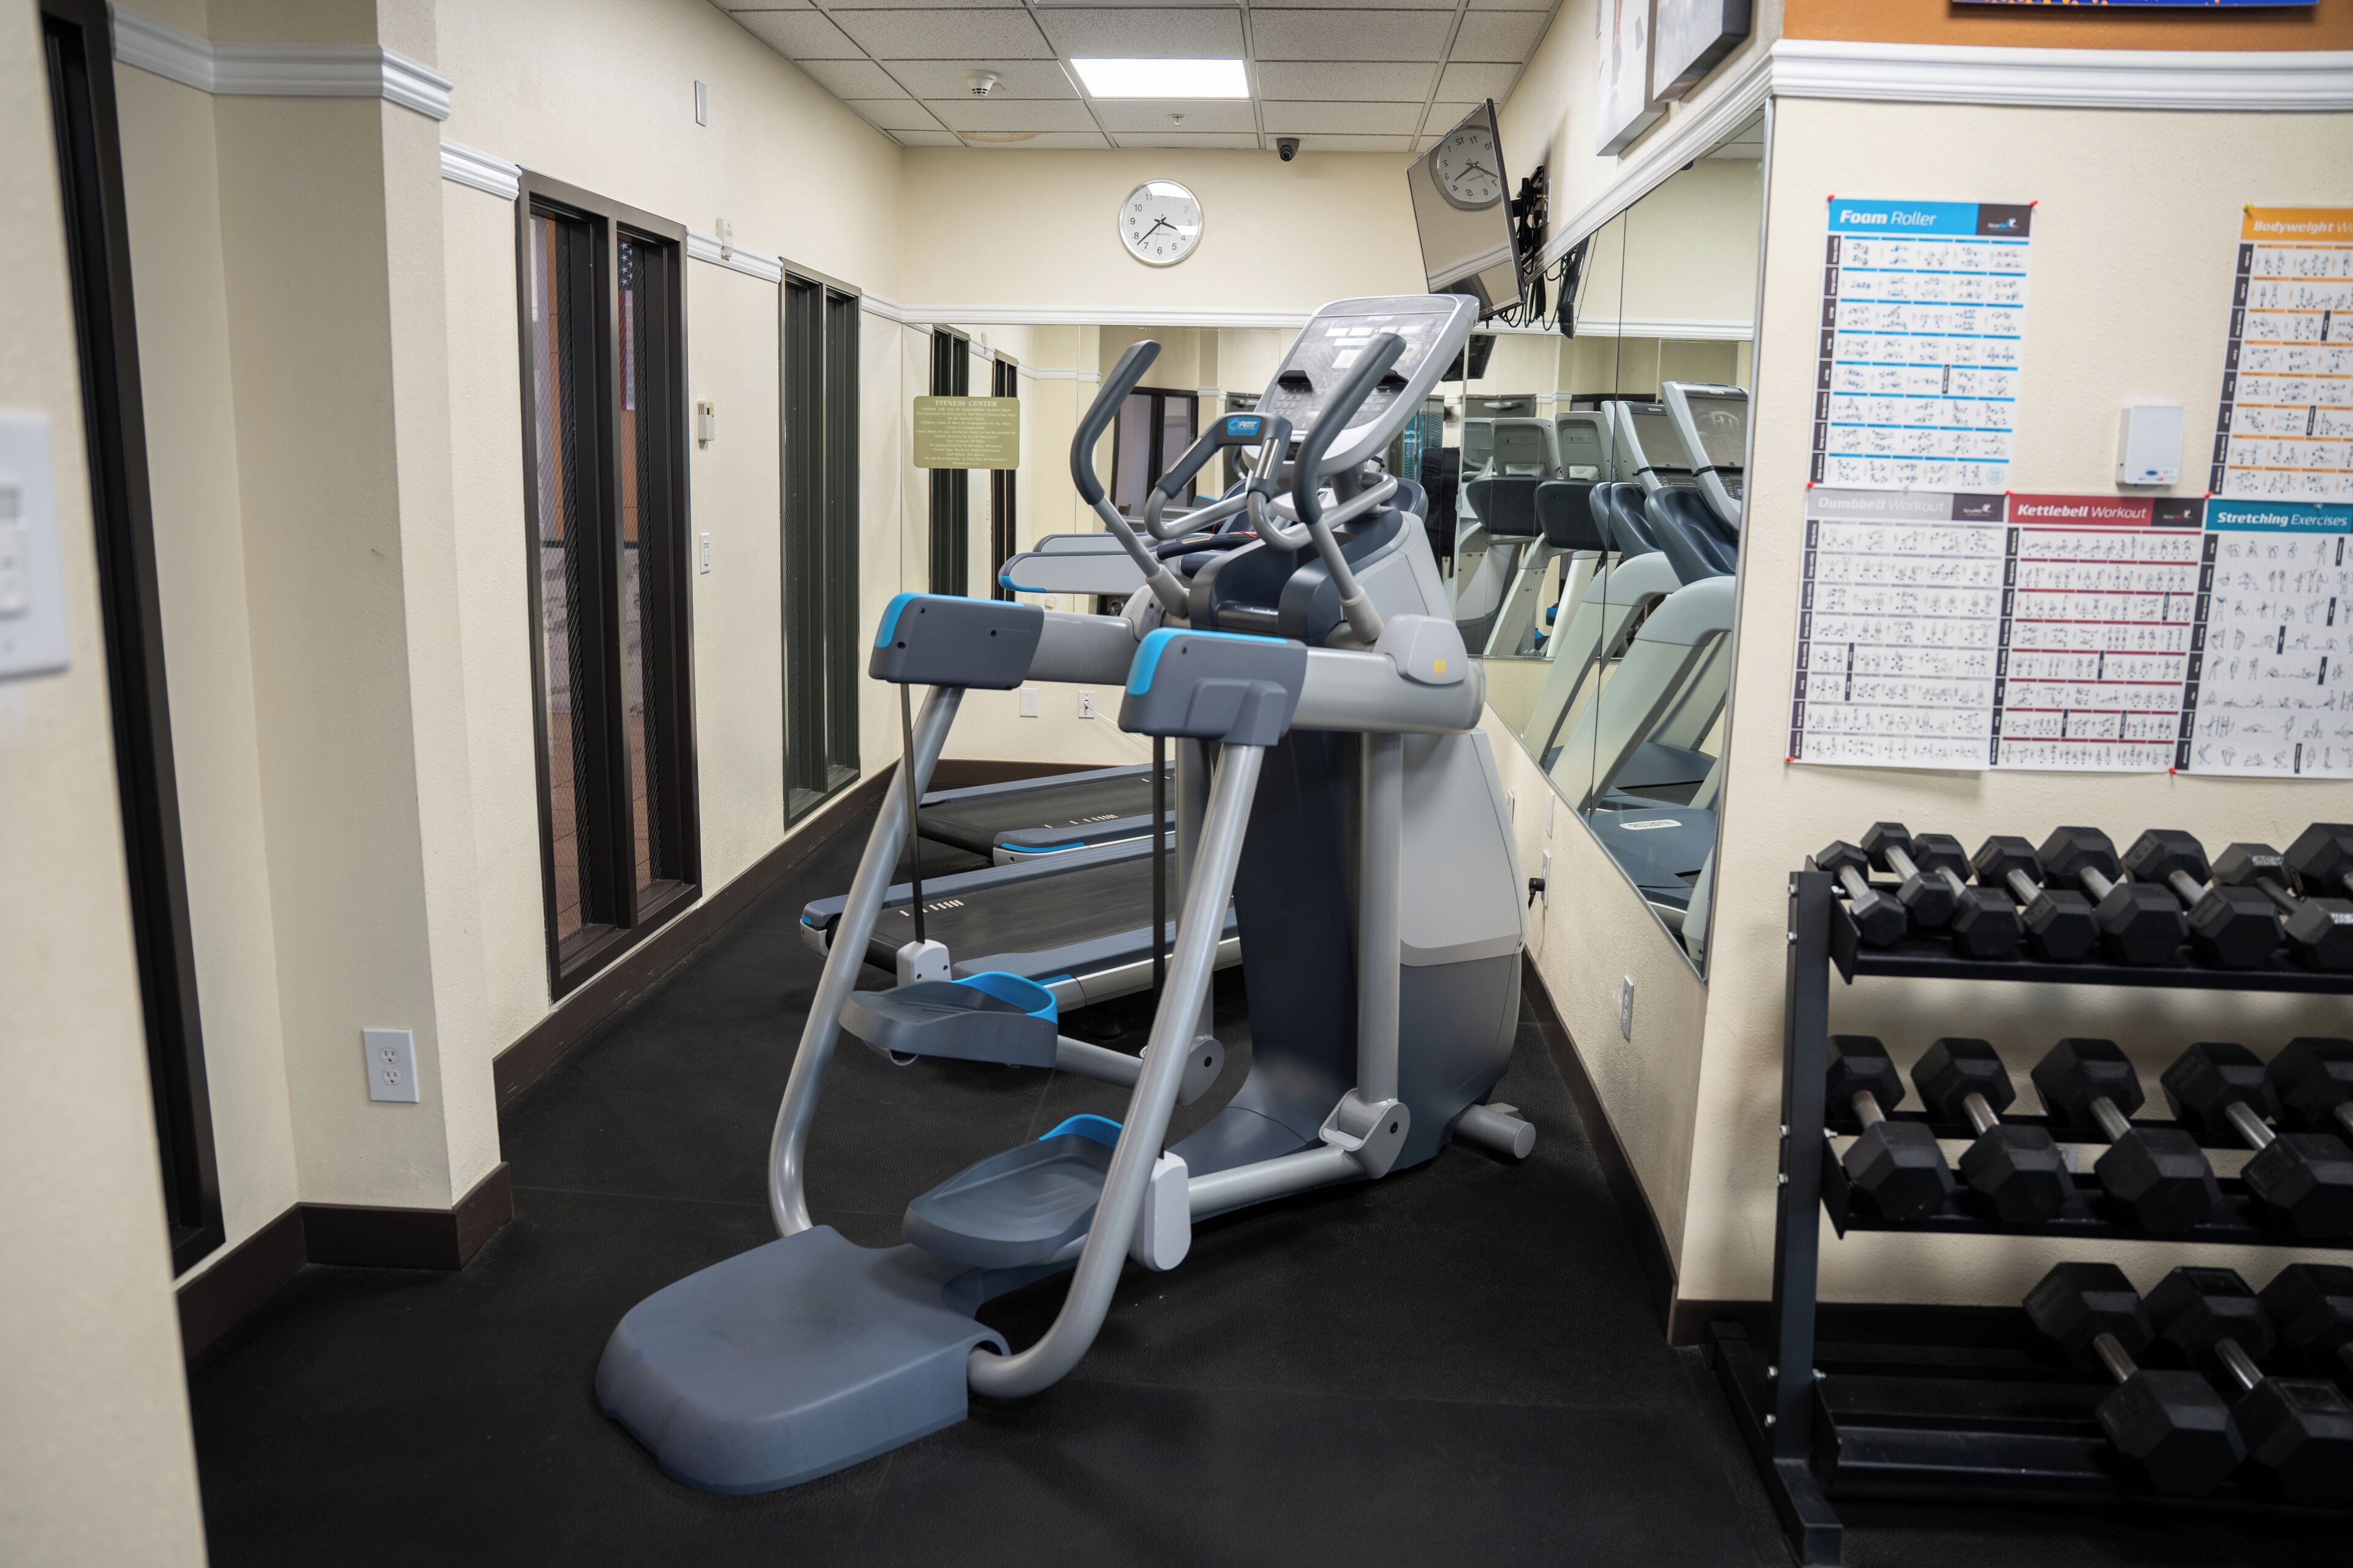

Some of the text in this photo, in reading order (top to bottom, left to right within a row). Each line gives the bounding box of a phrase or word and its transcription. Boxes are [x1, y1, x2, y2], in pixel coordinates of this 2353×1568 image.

[1839, 210, 1937, 226] Foam Roller
[2254, 221, 2334, 235] Bodyweight
[1818, 497, 1944, 513] Dumbbell Workout
[2018, 504, 2089, 518] Kettlebell
[2091, 506, 2146, 519] Workout
[2218, 512, 2348, 527] Stretching Exercises
